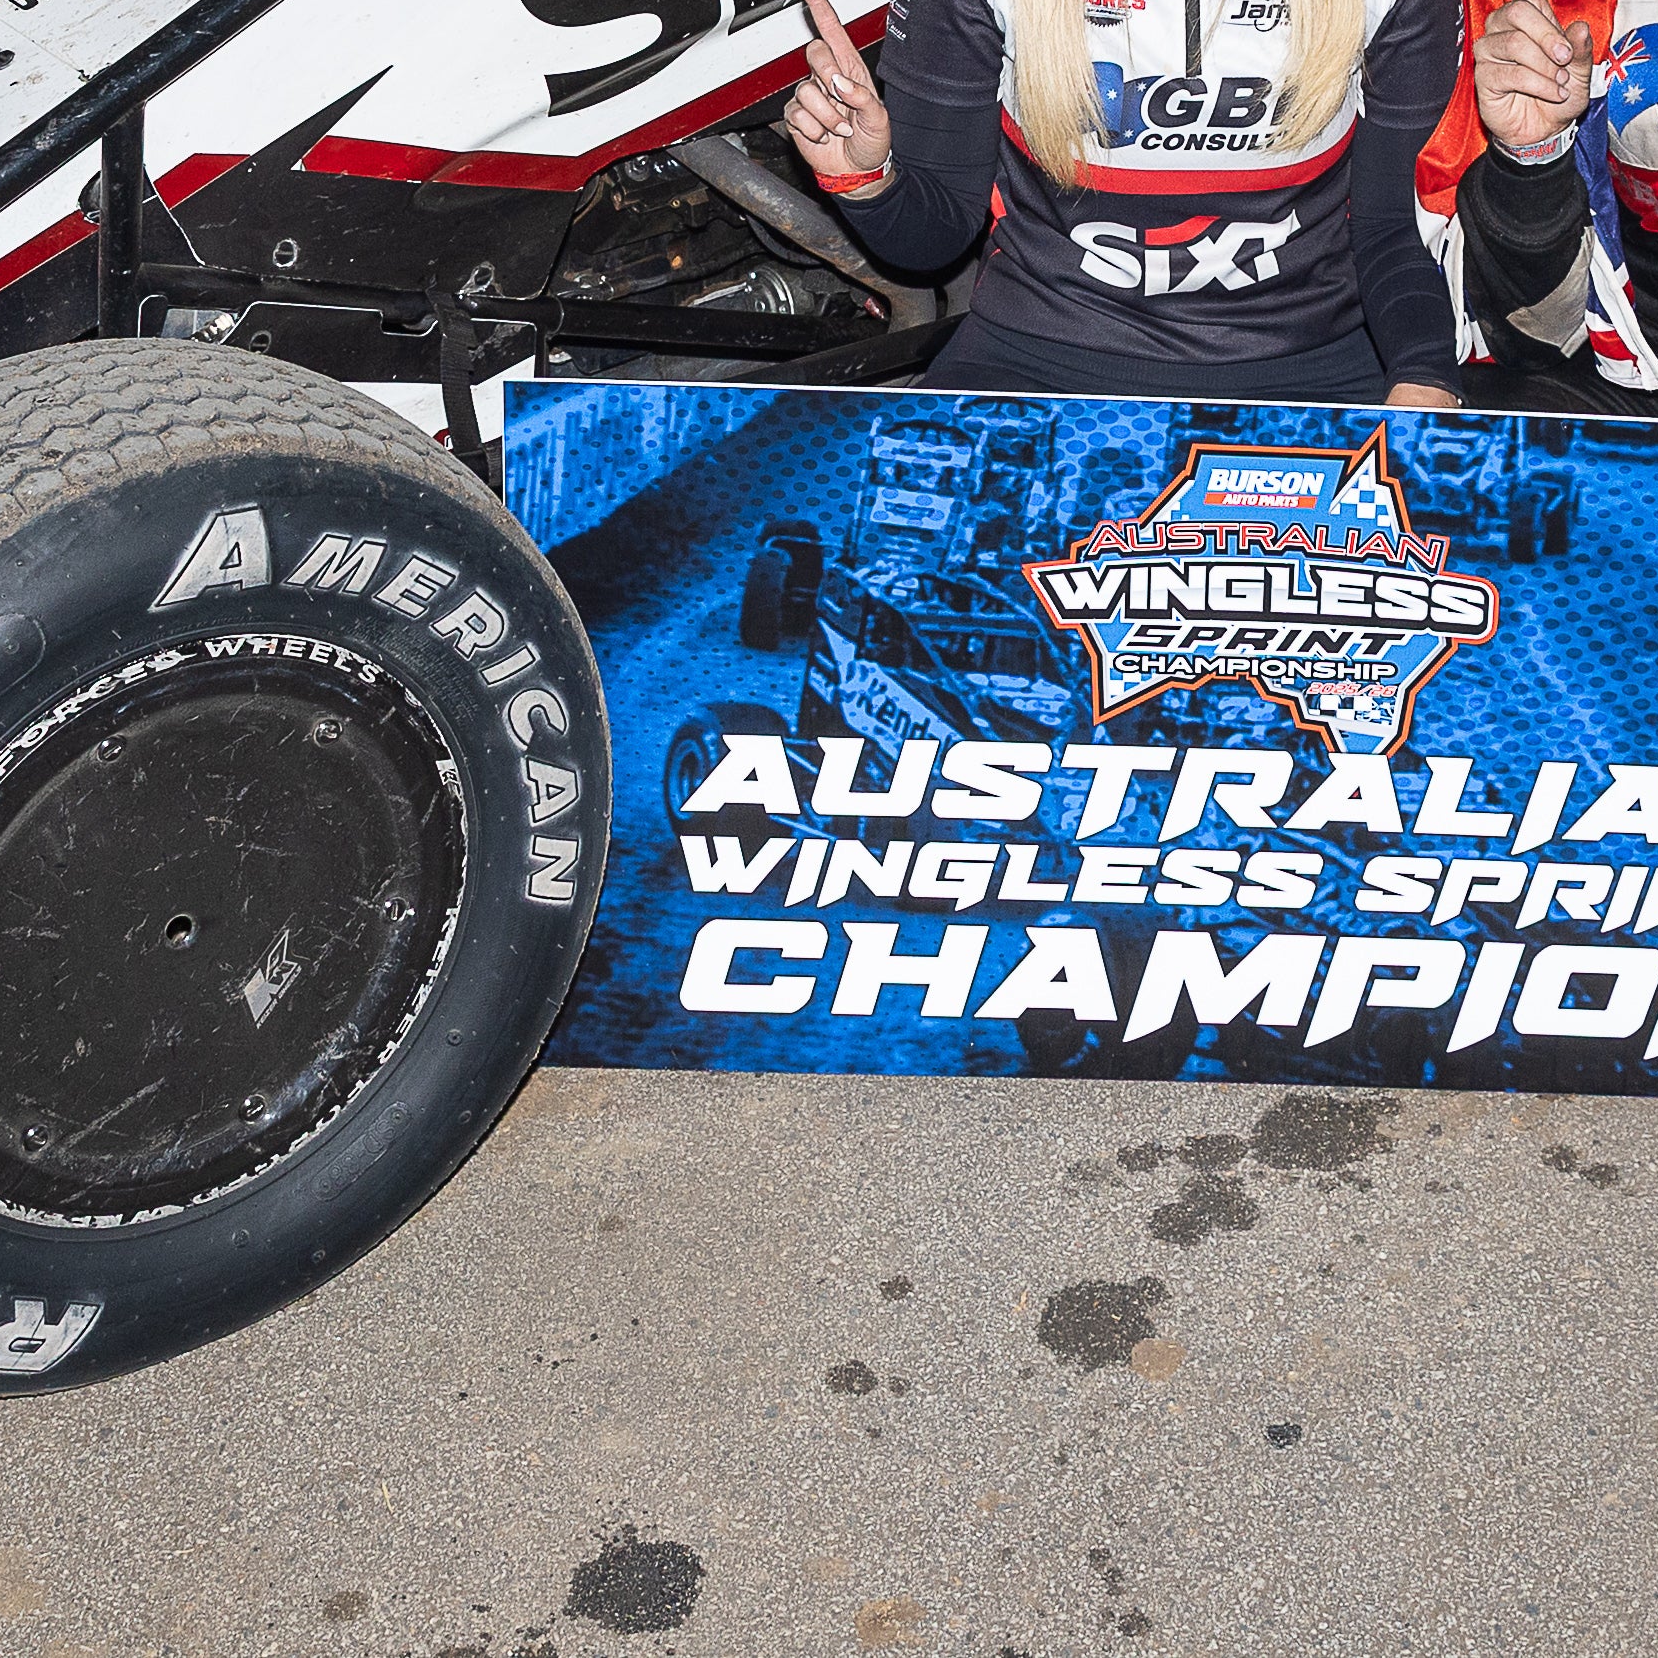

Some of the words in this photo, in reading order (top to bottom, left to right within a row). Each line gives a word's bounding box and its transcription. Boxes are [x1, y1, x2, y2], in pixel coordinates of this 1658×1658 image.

[1206, 467, 1326, 497] BURSON
[1222, 493, 1258, 506] AUTO
[1258, 494, 1300, 509] PARTS
[1089, 523, 1442, 571] AUSTRALIAN
[1045, 564, 1486, 627] WINGLESS
[204, 637, 379, 684] WHEELS
[1120, 624, 1408, 659] SPRINT
[1113, 654, 1399, 681] CHAMPIONSHIP
[149, 504, 585, 907] AMERICAN
[1306, 681, 1398, 698] 2025/26
[678, 833, 1326, 912] WINGLESS
